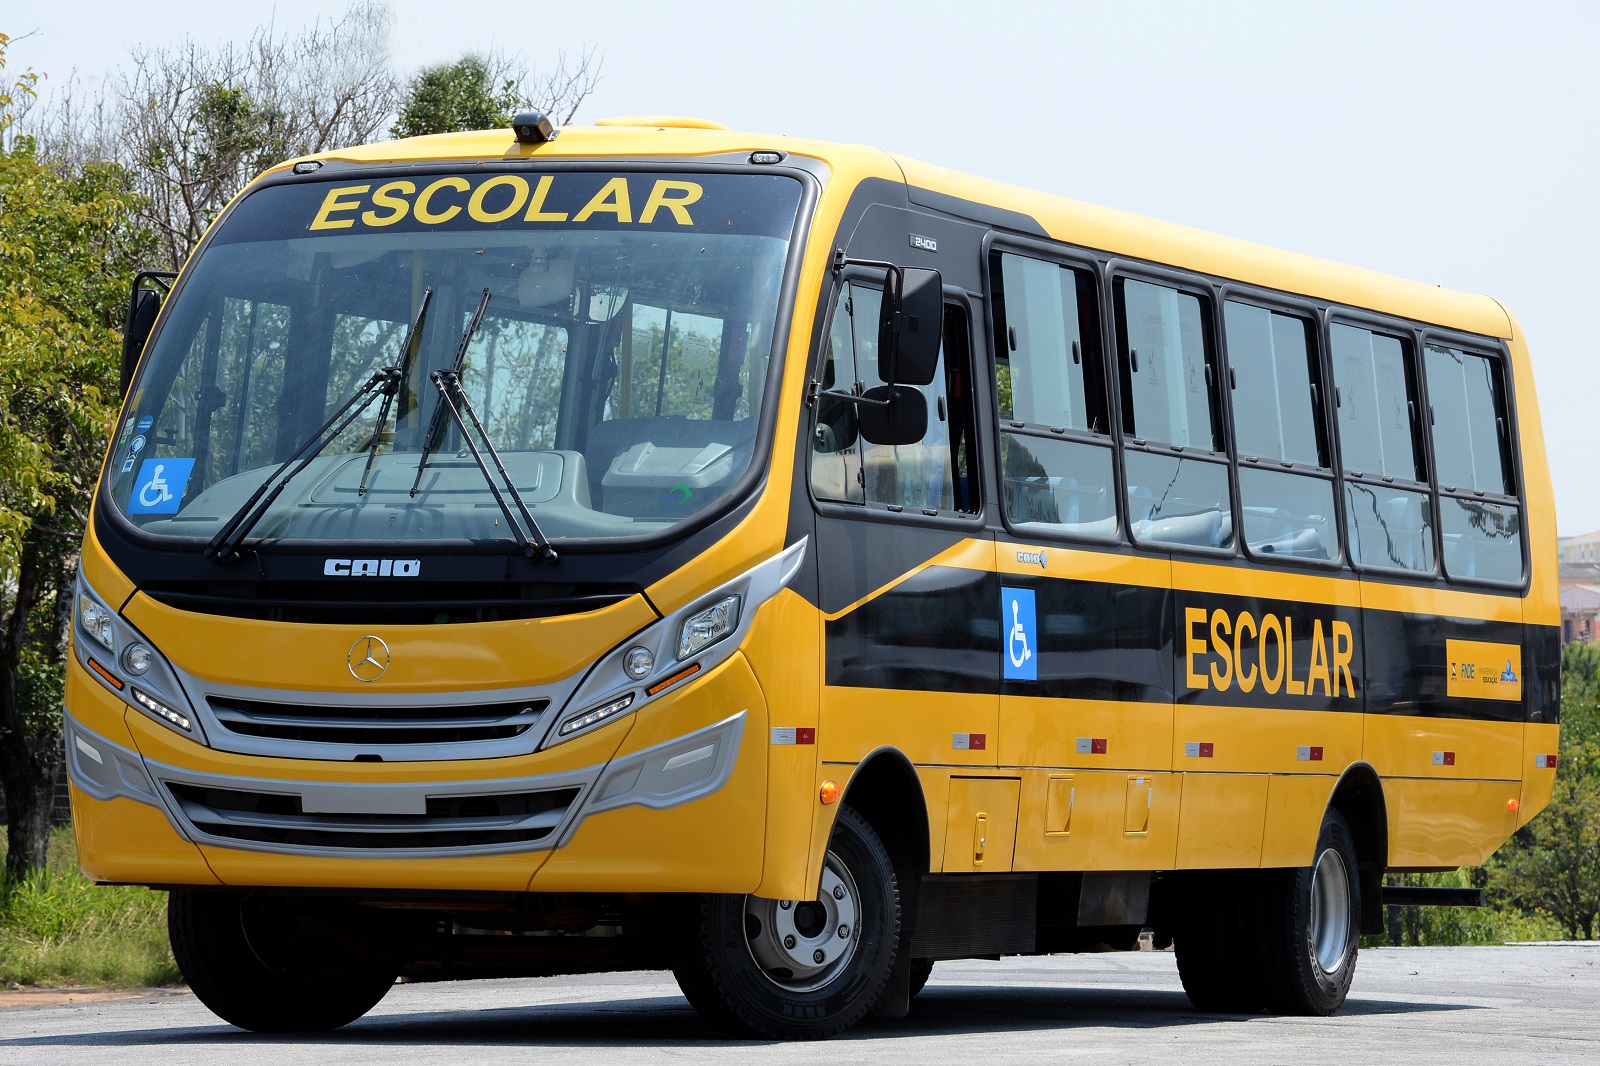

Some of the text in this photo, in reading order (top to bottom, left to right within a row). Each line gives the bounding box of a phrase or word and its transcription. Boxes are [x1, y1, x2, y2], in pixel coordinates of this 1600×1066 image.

[309, 175, 703, 231] ESCOLAR
[323, 559, 421, 577] CAIO
[1185, 607, 1356, 699] ESCOLAR
